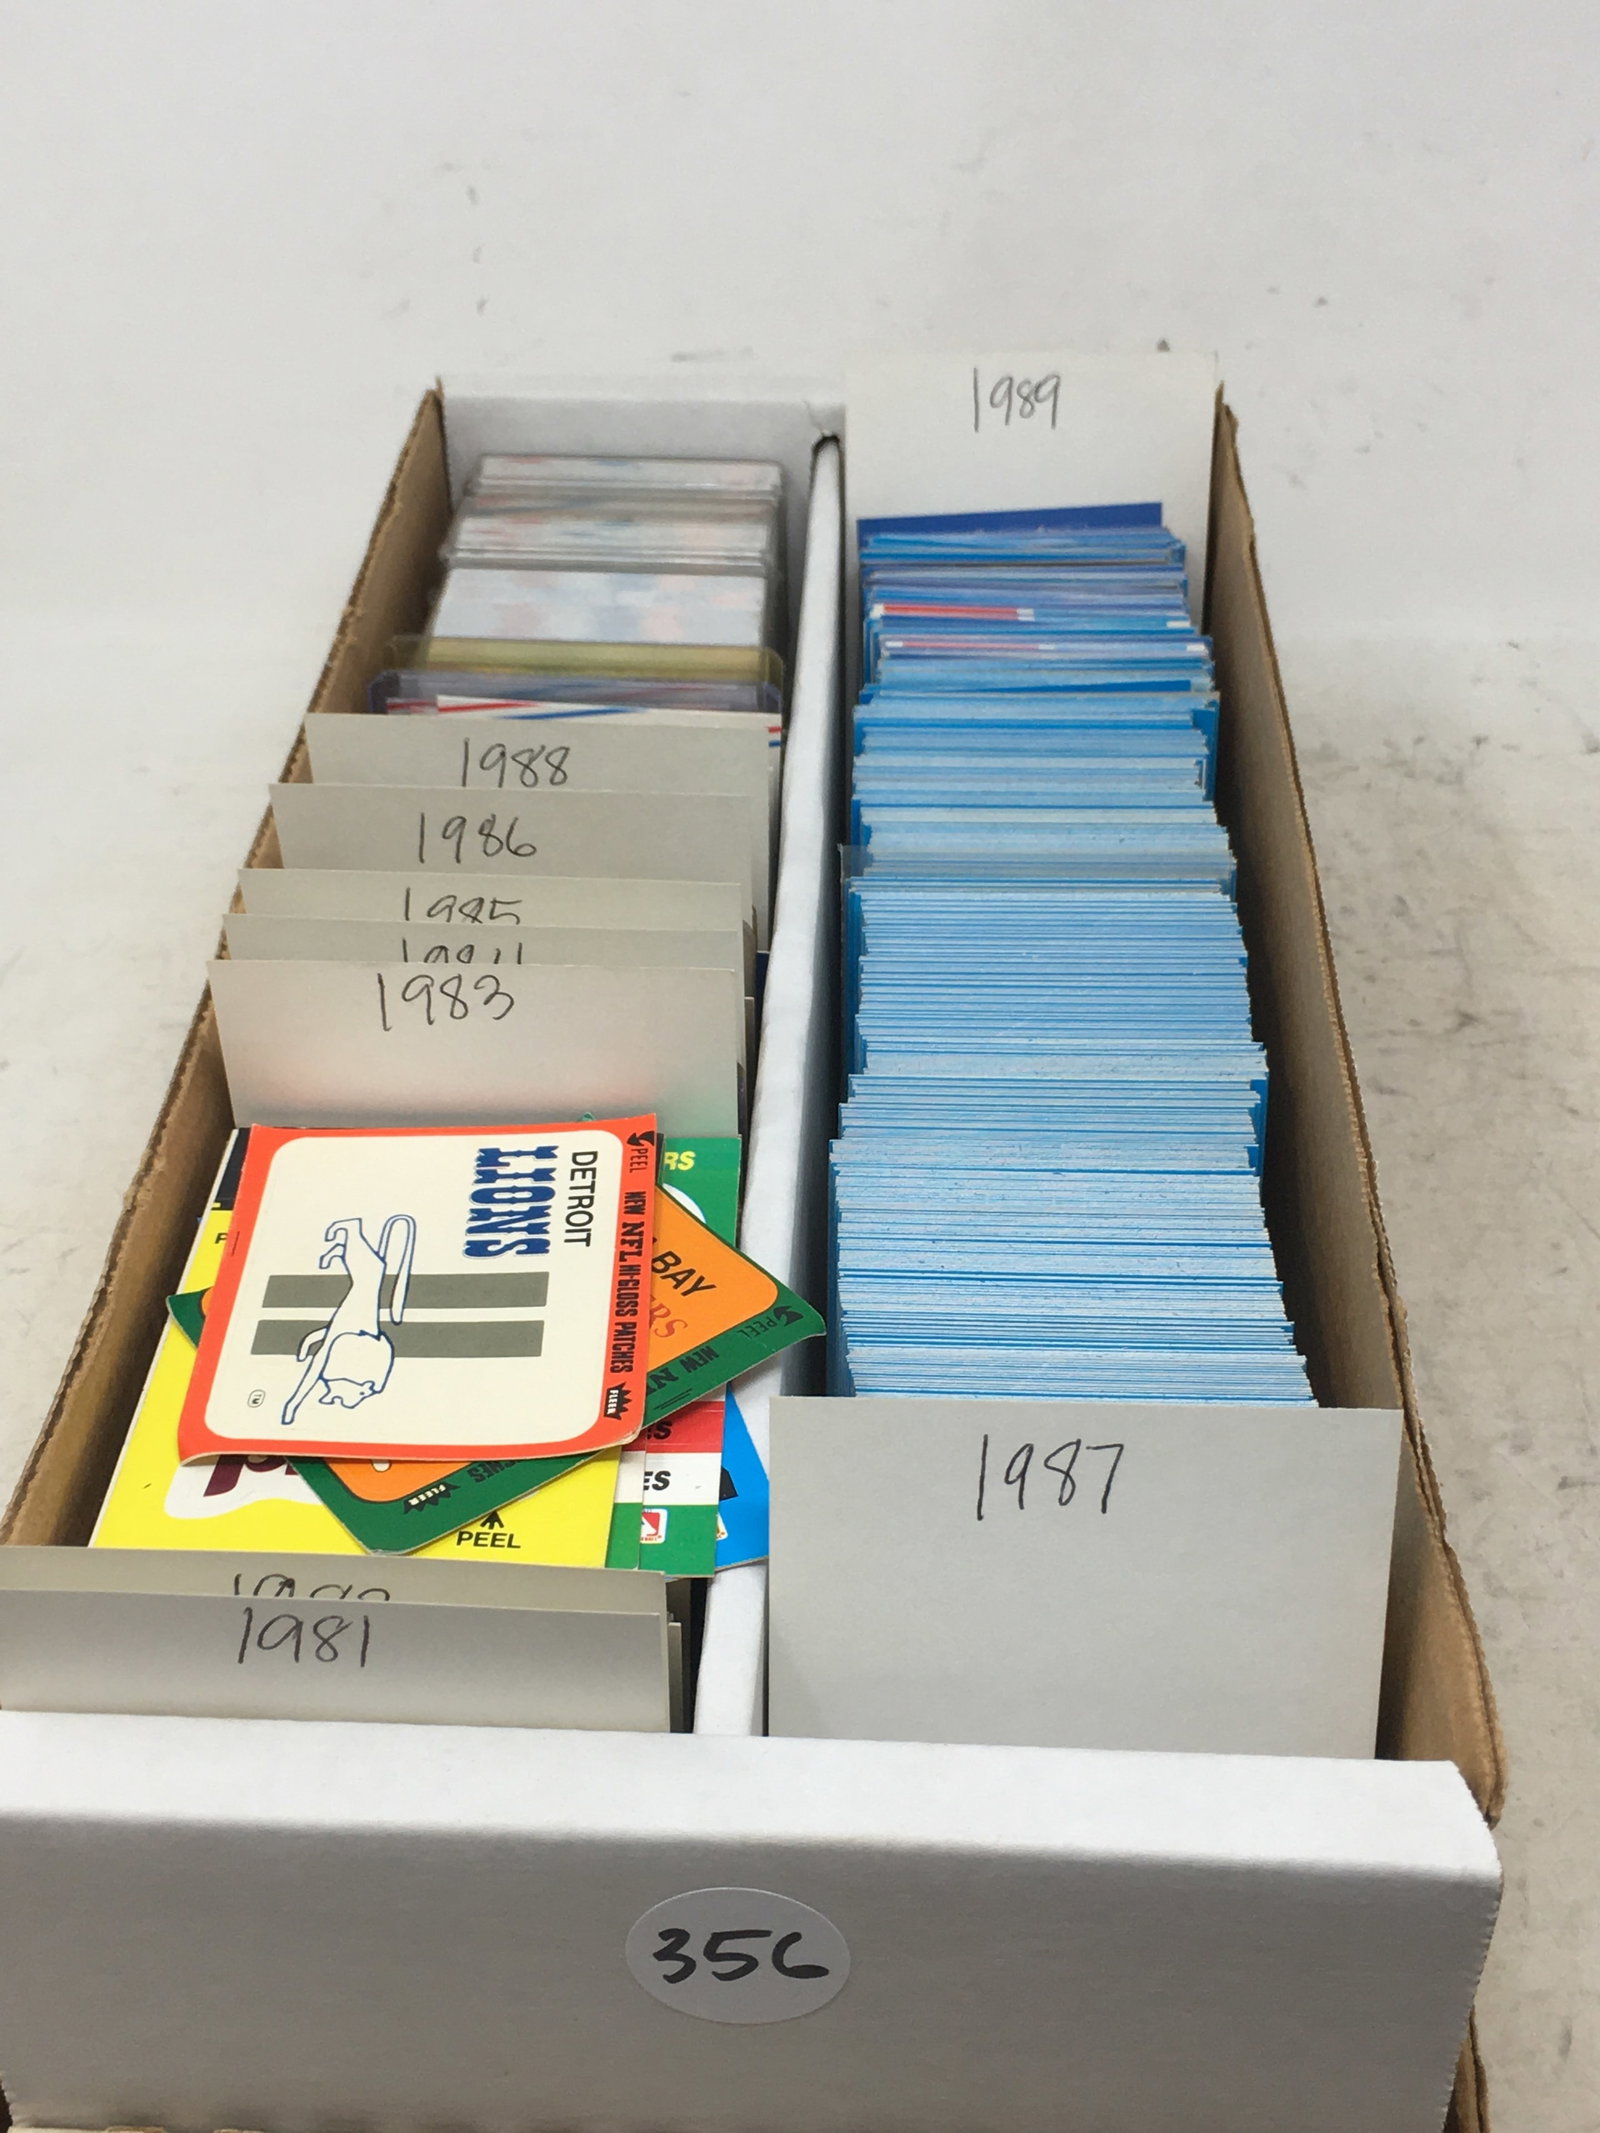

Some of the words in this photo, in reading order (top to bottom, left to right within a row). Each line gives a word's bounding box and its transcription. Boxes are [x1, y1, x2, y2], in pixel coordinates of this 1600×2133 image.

[973, 367, 1060, 433] 1989
[463, 737, 570, 787] 1988
[417, 811, 537, 863] 1986
[378, 973, 515, 1031] 1983
[629, 1147, 649, 1173] PEEL
[462, 1145, 560, 1258] LIONS
[563, 1150, 599, 1247] DETROIT
[624, 1191, 646, 1215] NEW
[619, 1221, 645, 1262] NFL
[651, 1250, 717, 1297] BAY
[610, 1321, 637, 1373] PATCHES
[737, 1320, 778, 1340] PEEL
[680, 1345, 720, 1373] NEW
[977, 1434, 1124, 1521] 1987
[456, 1530, 521, 1549] PEEL
[237, 1606, 370, 1668] 1981
